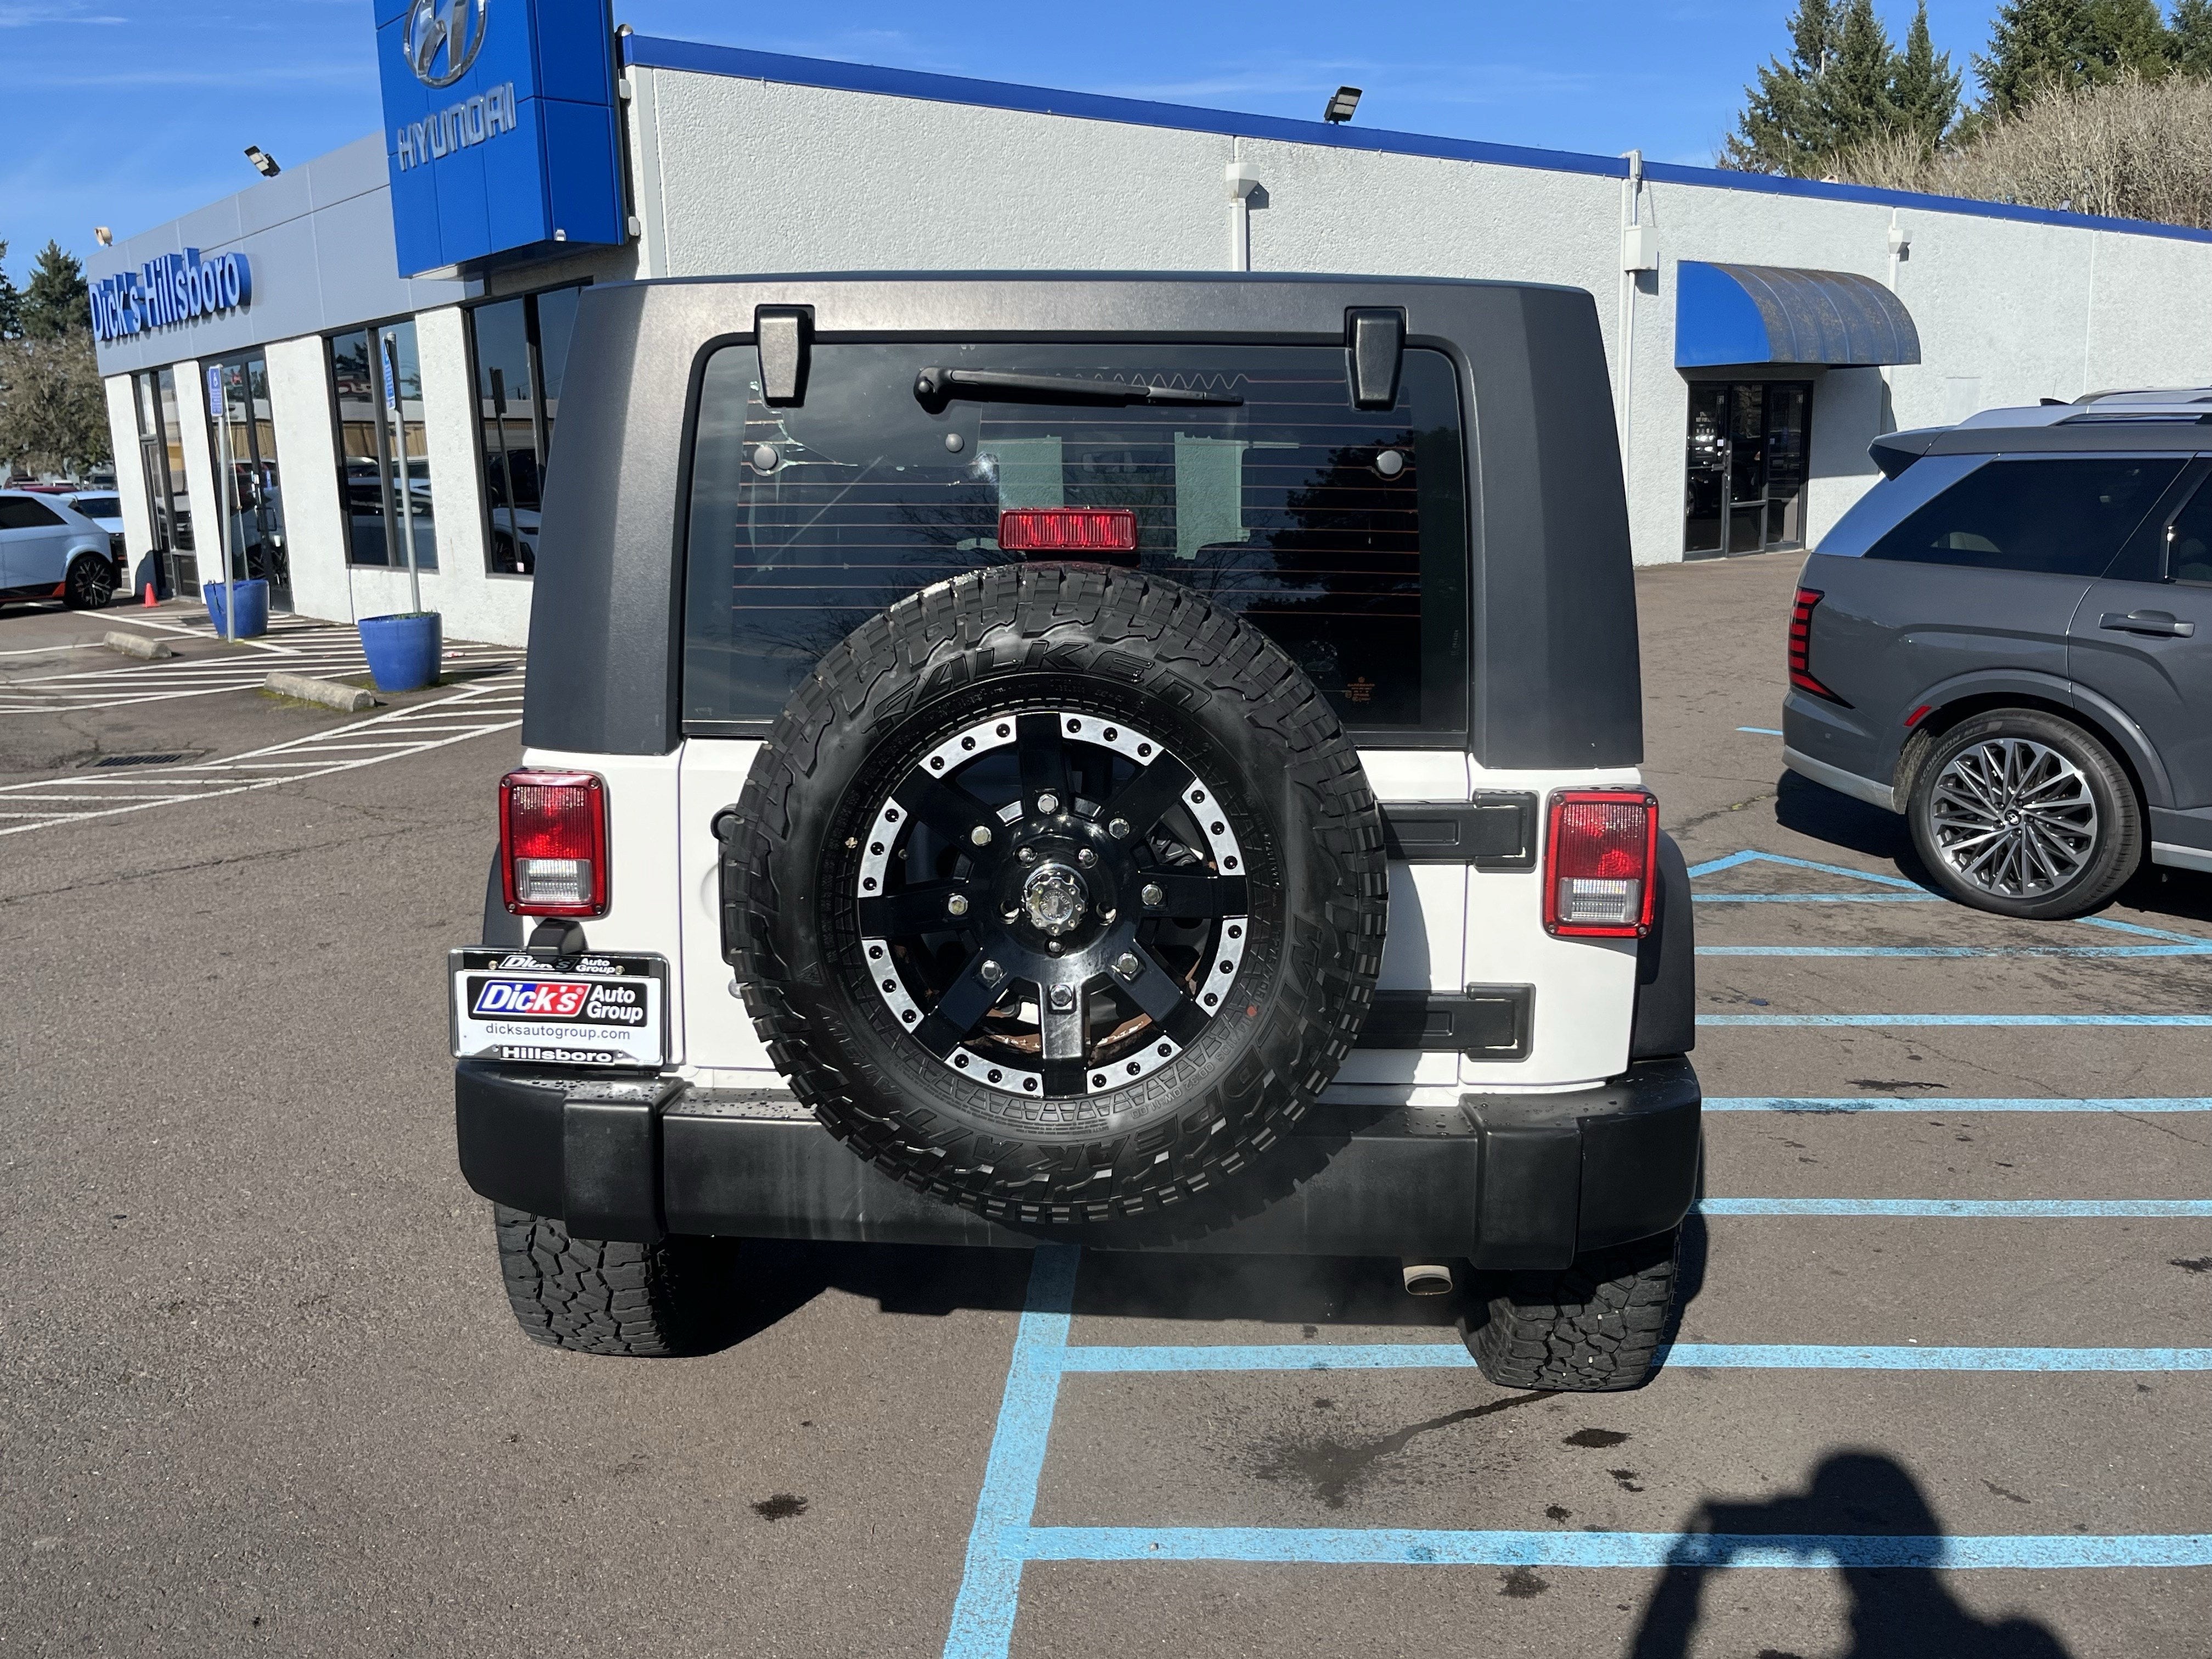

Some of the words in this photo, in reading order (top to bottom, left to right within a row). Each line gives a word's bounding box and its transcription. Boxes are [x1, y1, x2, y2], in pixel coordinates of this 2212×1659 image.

[398, 82, 516, 172] HYUNDAI
[89, 272, 141, 342] Dick's
[142, 247, 243, 328] Hillsboro
[1920, 735, 1961, 785] SCORPION
[575, 964, 616, 974] Group
[580, 957, 611, 966] Auto
[481, 984, 580, 1012] Dick's
[589, 985, 636, 1003] Auto
[586, 1002, 644, 1024] Group
[486, 1022, 630, 1040] dicksautogroup.com
[502, 1046, 612, 1063] Hillsboro
[1026, 915, 1322, 1172] WILDPEAK
